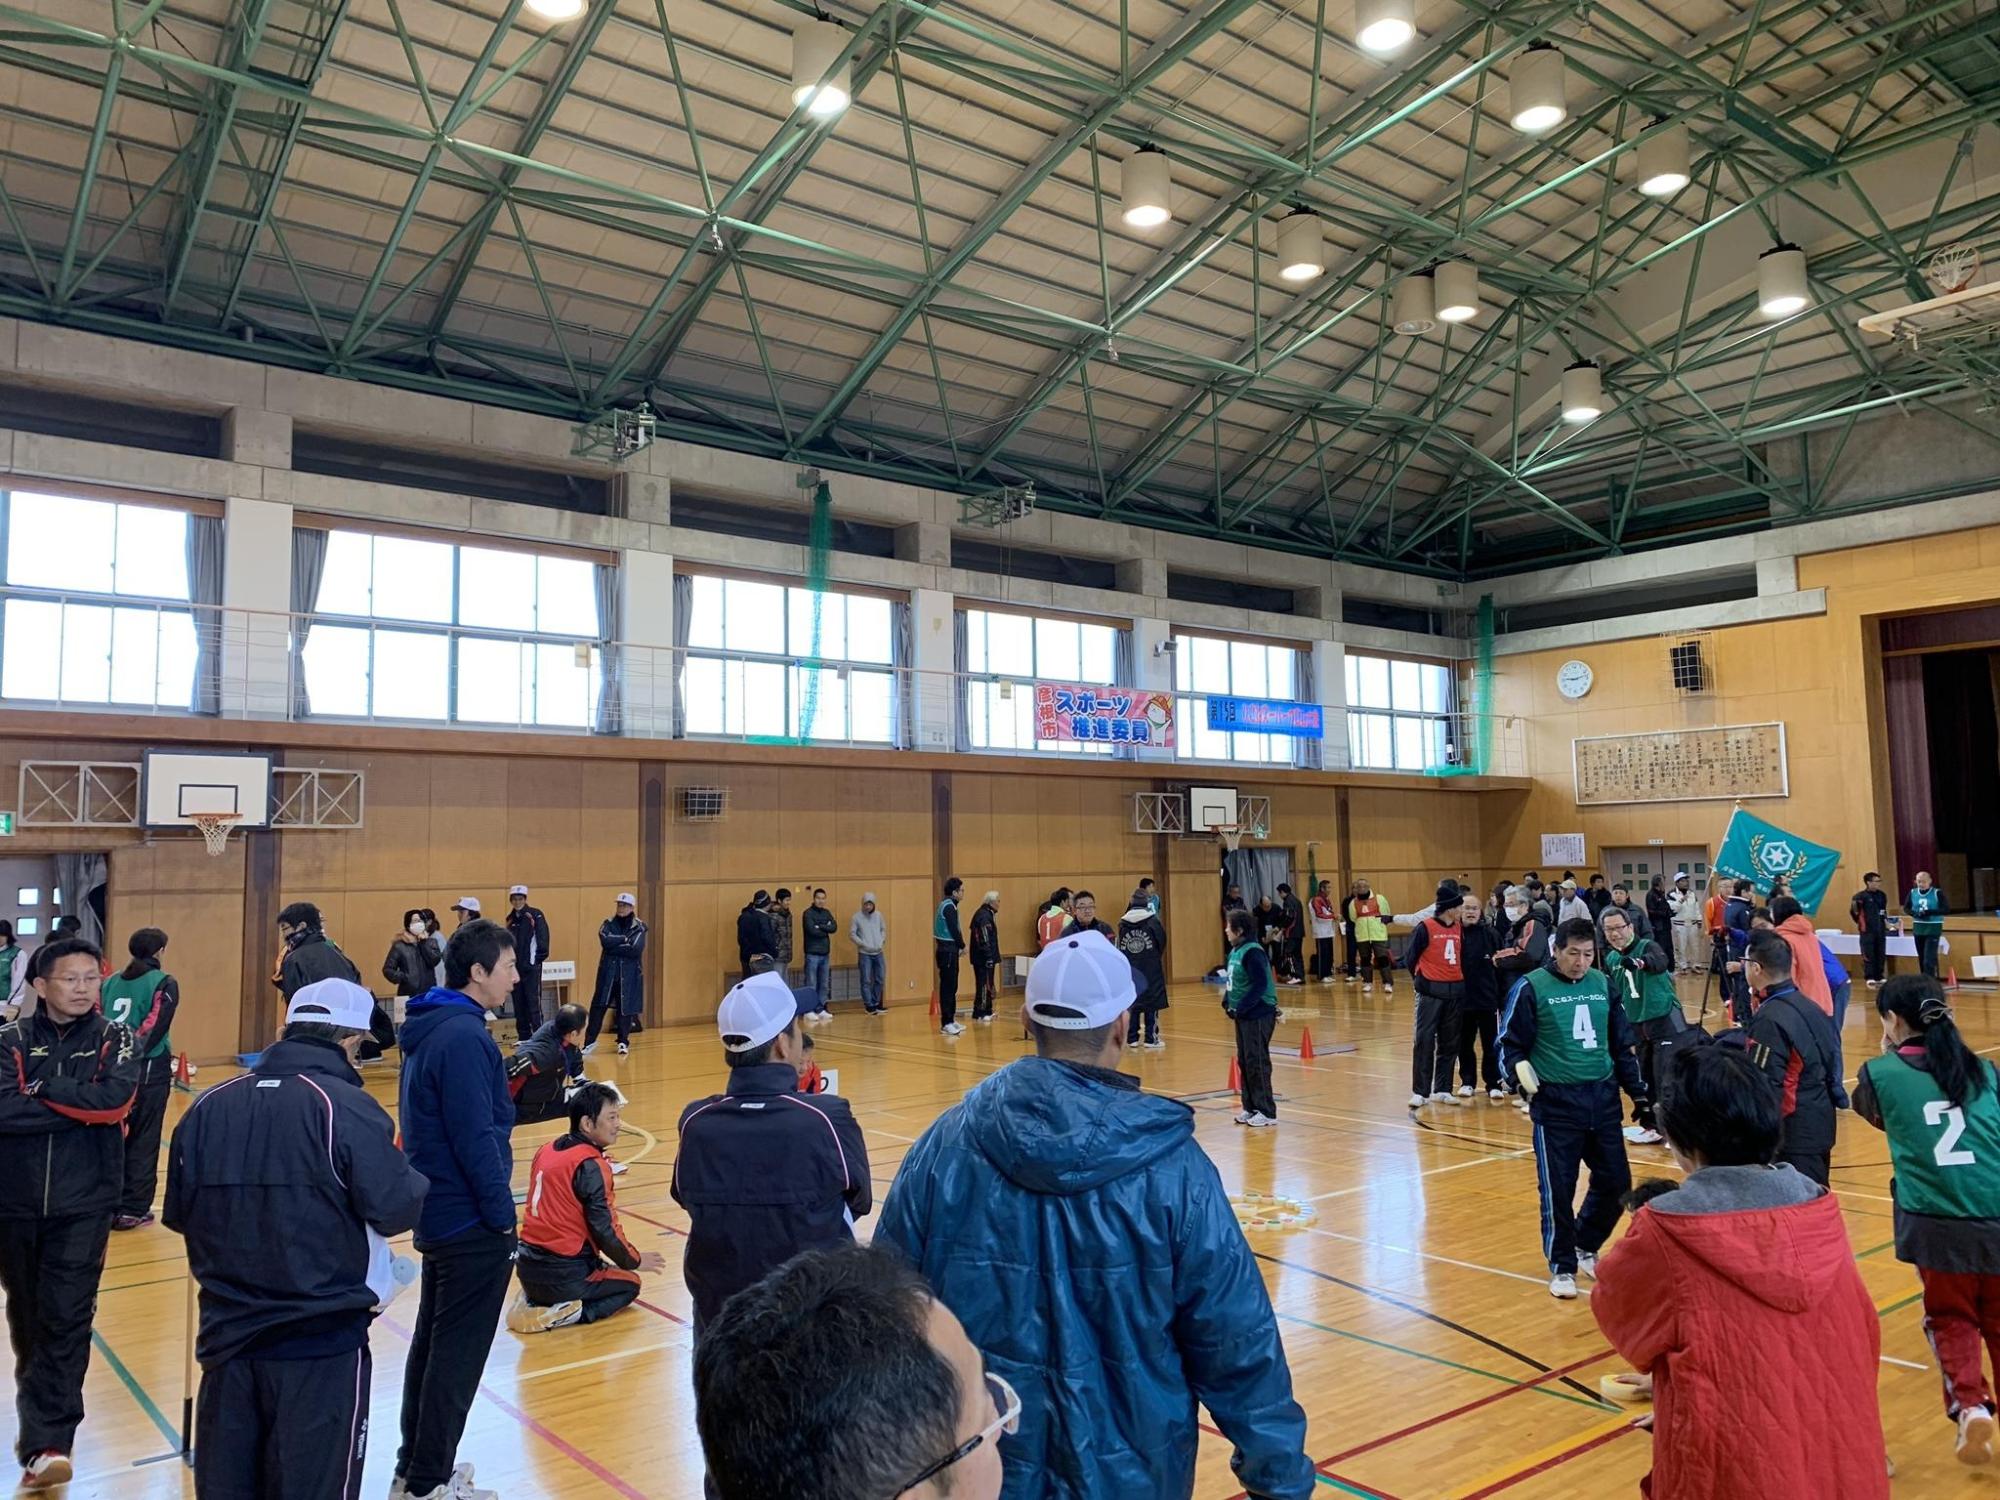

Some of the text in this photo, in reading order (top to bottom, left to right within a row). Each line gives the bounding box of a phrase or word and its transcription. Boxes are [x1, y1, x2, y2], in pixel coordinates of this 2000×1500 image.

[1037, 685, 1058, 738] 彦根市
[1055, 689, 1131, 717] スポーツ
[1071, 714, 1149, 743] 推進委員
[1444, 938, 1457, 965] 4
[1624, 968, 1640, 999] 1
[1572, 1004, 1598, 1049] 4
[1922, 1100, 1976, 1167] 2
[531, 1169, 544, 1217] 1
